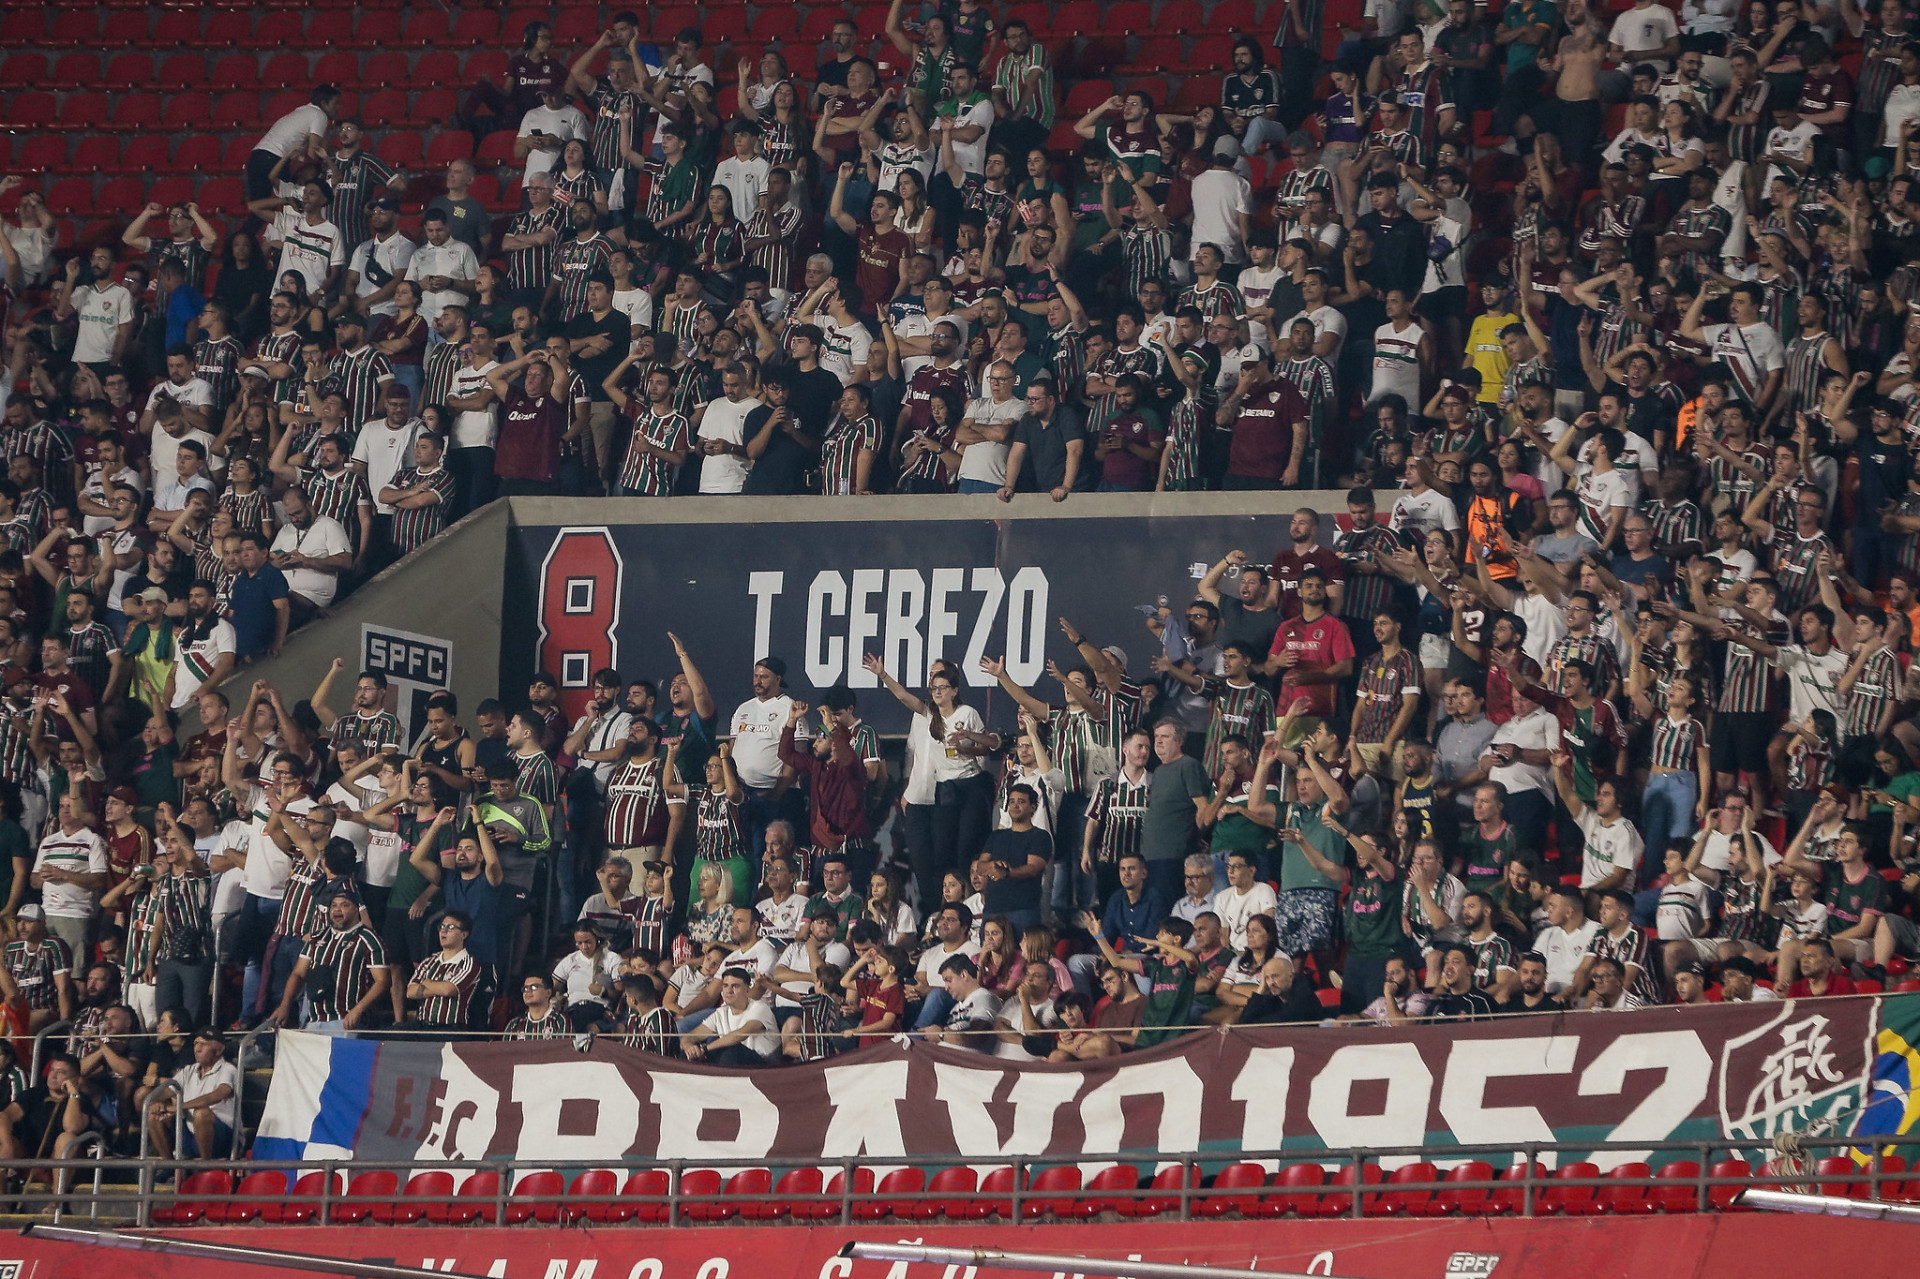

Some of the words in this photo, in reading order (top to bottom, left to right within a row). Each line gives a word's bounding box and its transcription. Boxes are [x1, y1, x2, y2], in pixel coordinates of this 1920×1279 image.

[771, 141, 794, 150] BETAN
[565, 262, 588, 271] BETANO
[1246, 409, 1275, 418] BETANO
[536, 526, 623, 728] 8
[748, 571, 784, 662] T
[804, 567, 1049, 688] CEREZO
[369, 637, 445, 682] SPFC
[745, 723, 770, 733] BETANO
[1110, 807, 1144, 818] Unime
[704, 818, 729, 829] BETANO
[1449, 1256, 1500, 1272] SPFC
